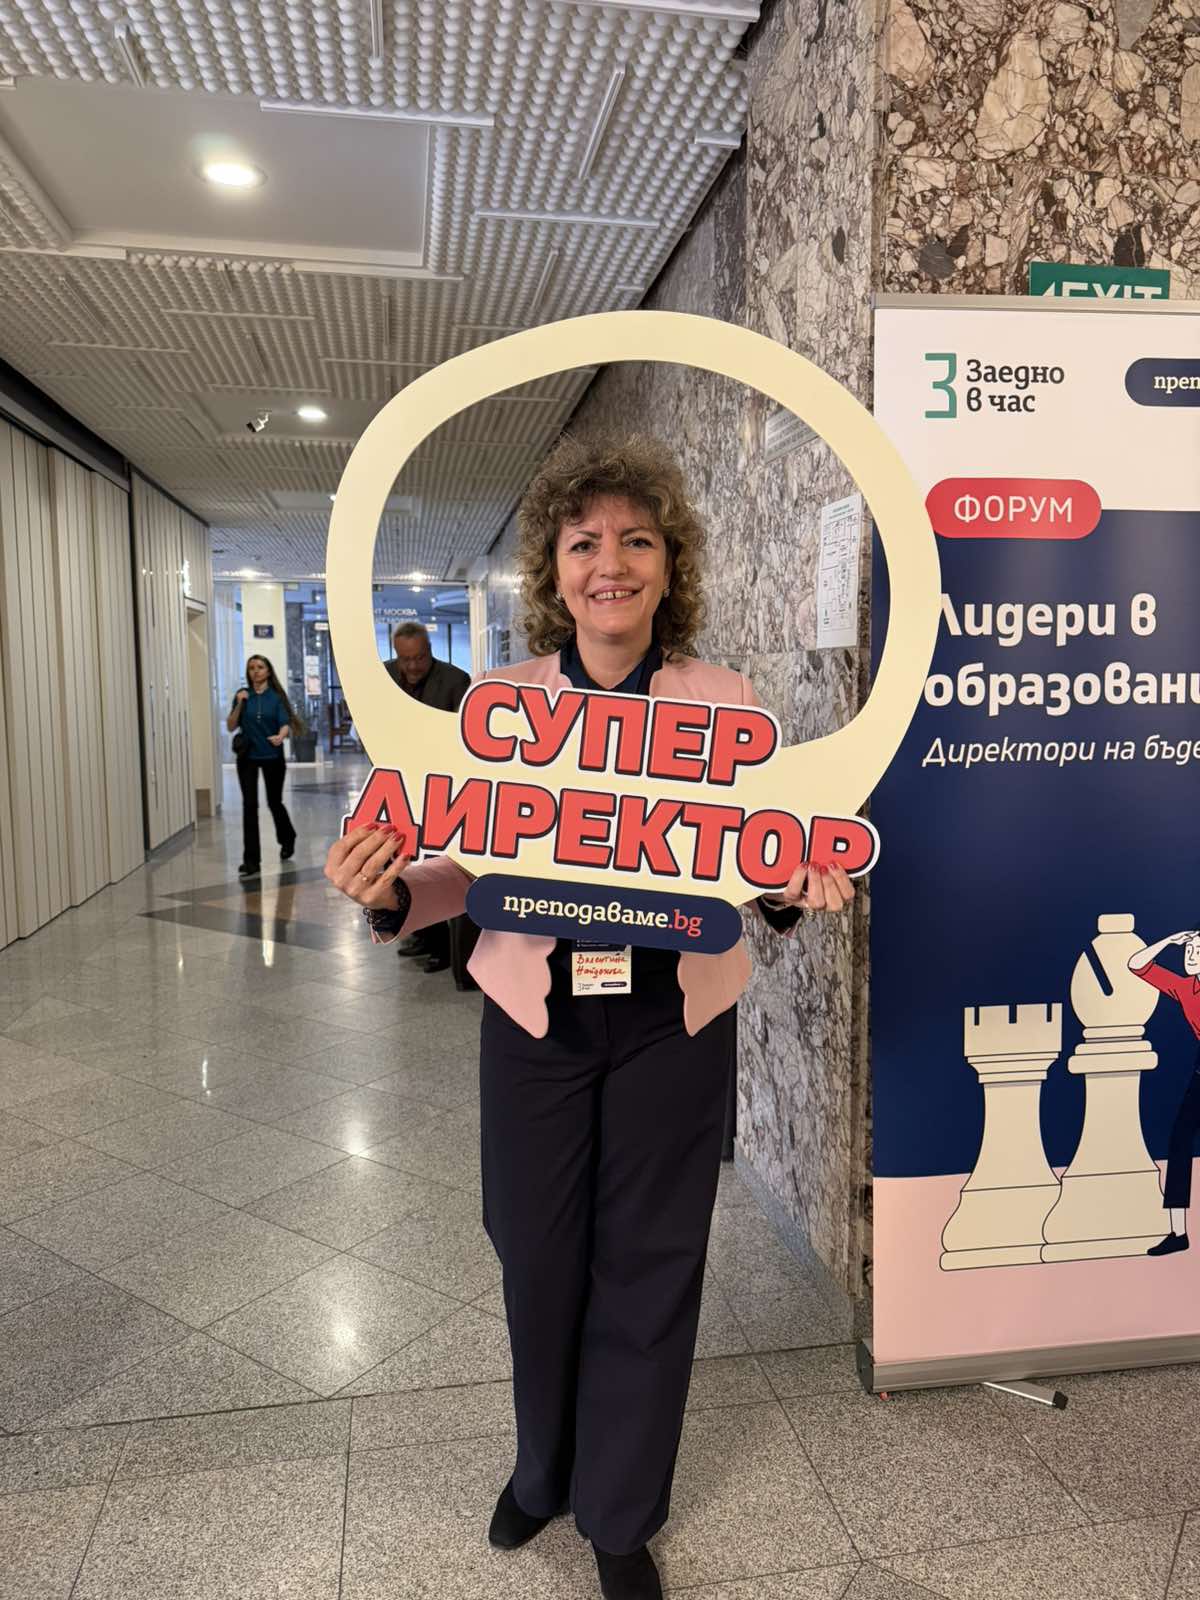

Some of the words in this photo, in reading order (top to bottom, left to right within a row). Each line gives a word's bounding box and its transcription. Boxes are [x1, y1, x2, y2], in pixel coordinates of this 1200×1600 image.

[966, 359, 1065, 390] Заедно
[966, 387, 982, 412] в
[988, 394, 1036, 412] час
[954, 494, 1073, 523] ФОРУМ
[1130, 592, 1157, 636] в
[460, 680, 778, 787] СУПЕР
[921, 736, 1096, 769] Директори
[1103, 740, 1135, 761] на
[342, 767, 876, 890] ДИРЕКТОР
[503, 895, 704, 937] преподаваме.bg
